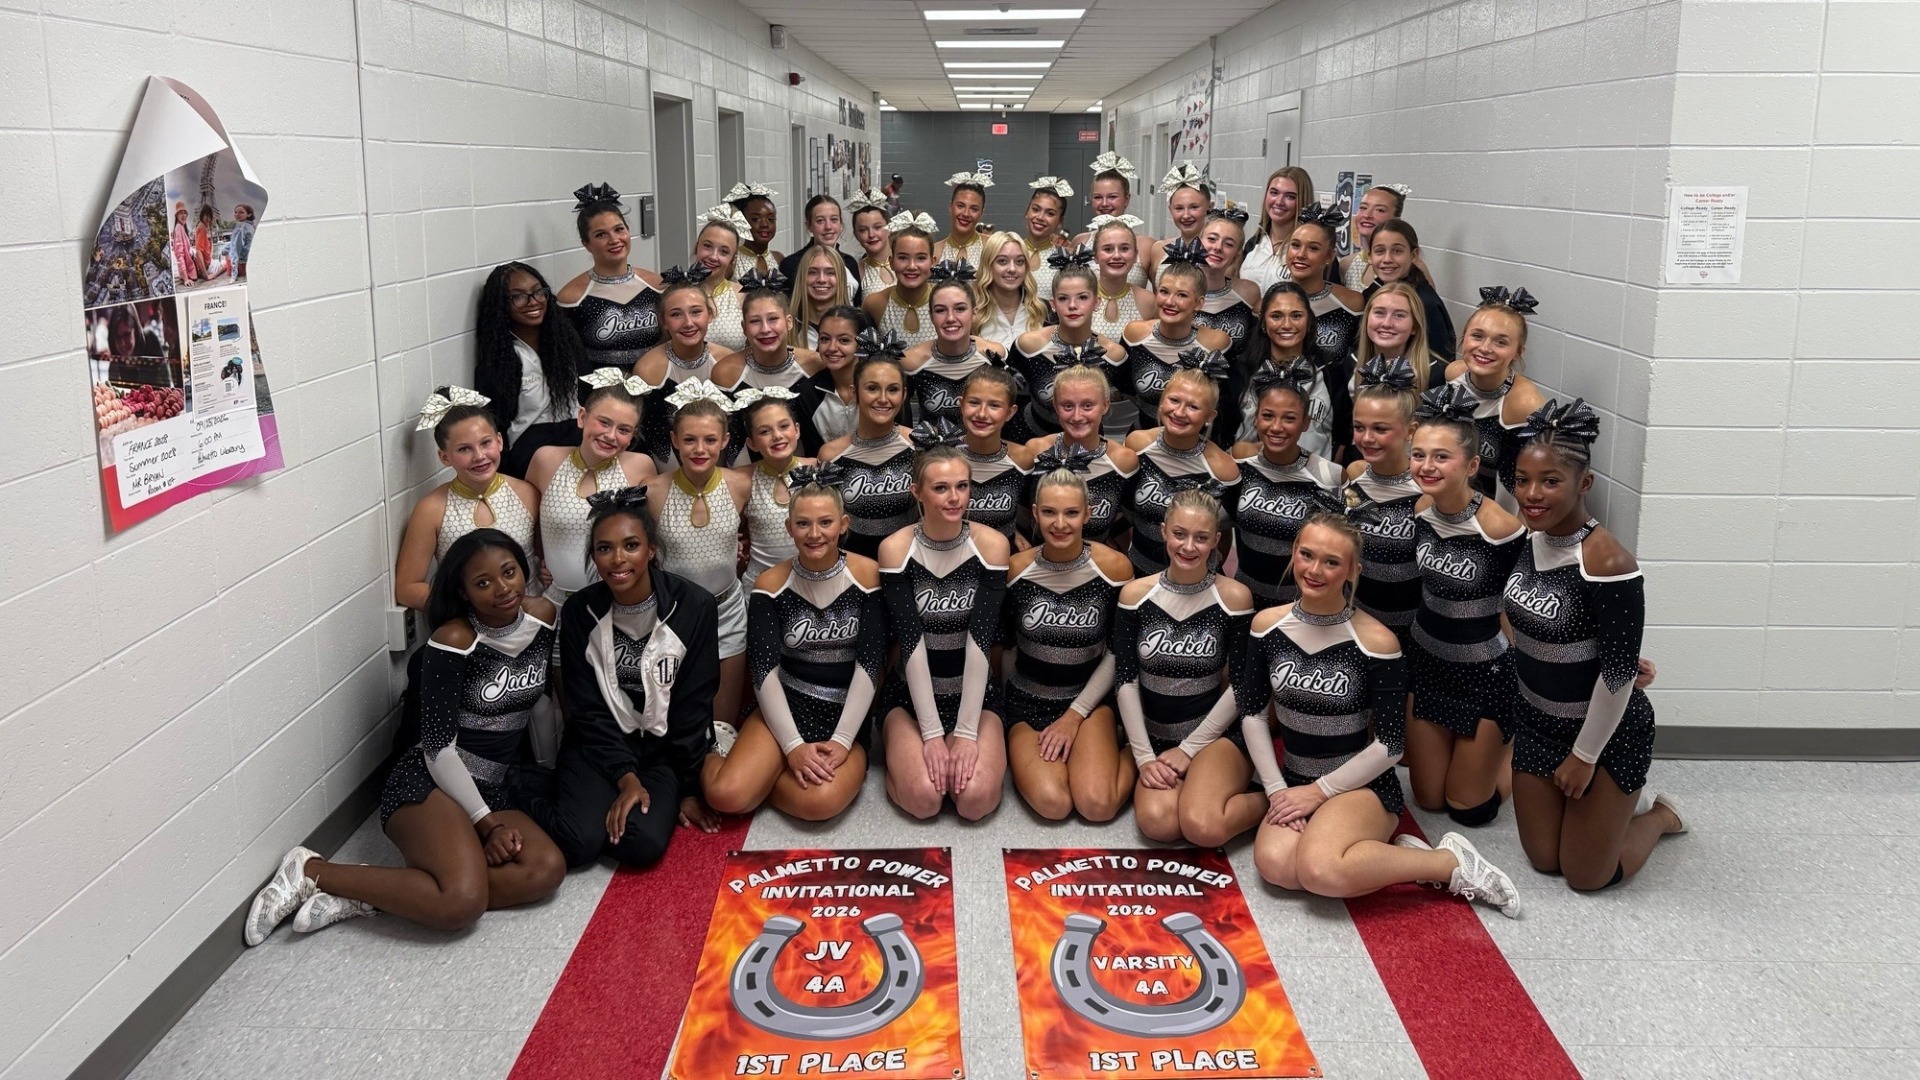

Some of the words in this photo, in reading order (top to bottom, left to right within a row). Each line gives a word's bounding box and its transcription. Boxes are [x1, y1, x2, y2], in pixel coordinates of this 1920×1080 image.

[129, 438, 153, 455] FRANCE
[129, 455, 158, 473] Summer
[1238, 487, 1307, 520] Jackets
[1416, 543, 1478, 582] Jackets
[1503, 572, 1560, 620] Jackets
[1022, 601, 1099, 631] Jackets
[1139, 629, 1217, 660] Jackets
[1269, 661, 1349, 696] Jackets
[728, 856, 861, 894] PALMETTO
[867, 858, 950, 889] POWER
[1013, 855, 1138, 891] PALMETTO
[1146, 858, 1233, 889] POWER
[760, 884, 915, 899] INVITATIONAL
[1050, 883, 1203, 897] INVITATIONAL
[810, 906, 861, 918] 2026
[1107, 905, 1157, 916] 2026
[804, 941, 852, 962] JV
[1092, 955, 1194, 970] VARSITY
[804, 976, 847, 994] 4A
[1135, 980, 1170, 996] 4A
[735, 1053, 789, 1076] 1ST
[798, 1048, 907, 1074] PLACE
[1088, 1051, 1139, 1072] 1ST
[1151, 1049, 1260, 1071] PLACE
